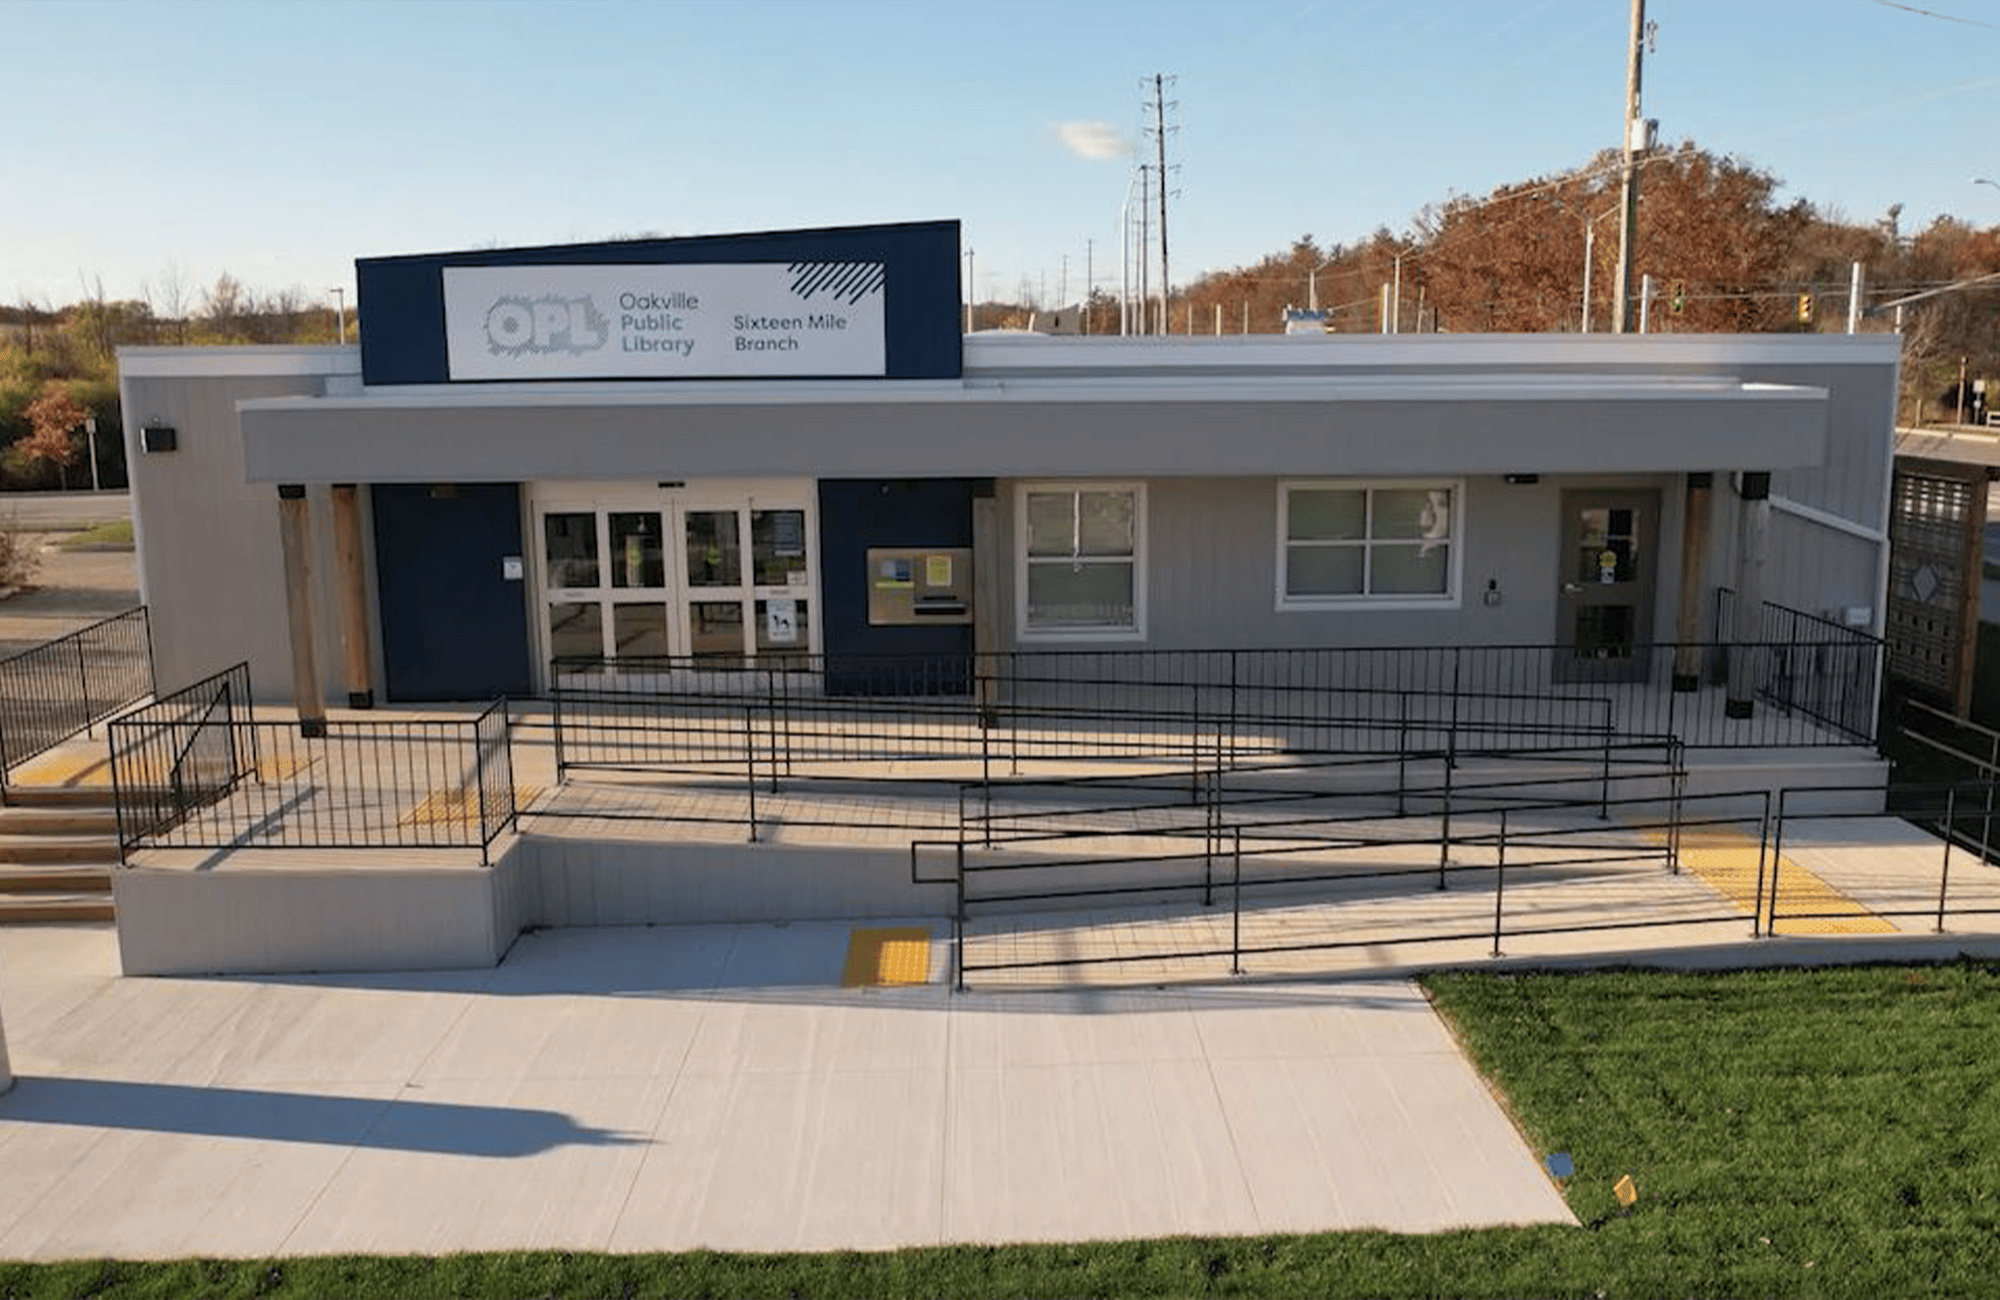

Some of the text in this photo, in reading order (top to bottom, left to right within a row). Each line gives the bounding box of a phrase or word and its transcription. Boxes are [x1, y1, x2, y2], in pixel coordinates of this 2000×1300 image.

[619, 291, 699, 311] Oakville
[484, 294, 609, 358] OPL
[620, 313, 682, 331] Public
[733, 313, 847, 331] Sixteen Mile
[621, 336, 695, 357] Library
[734, 336, 799, 352] Branch
